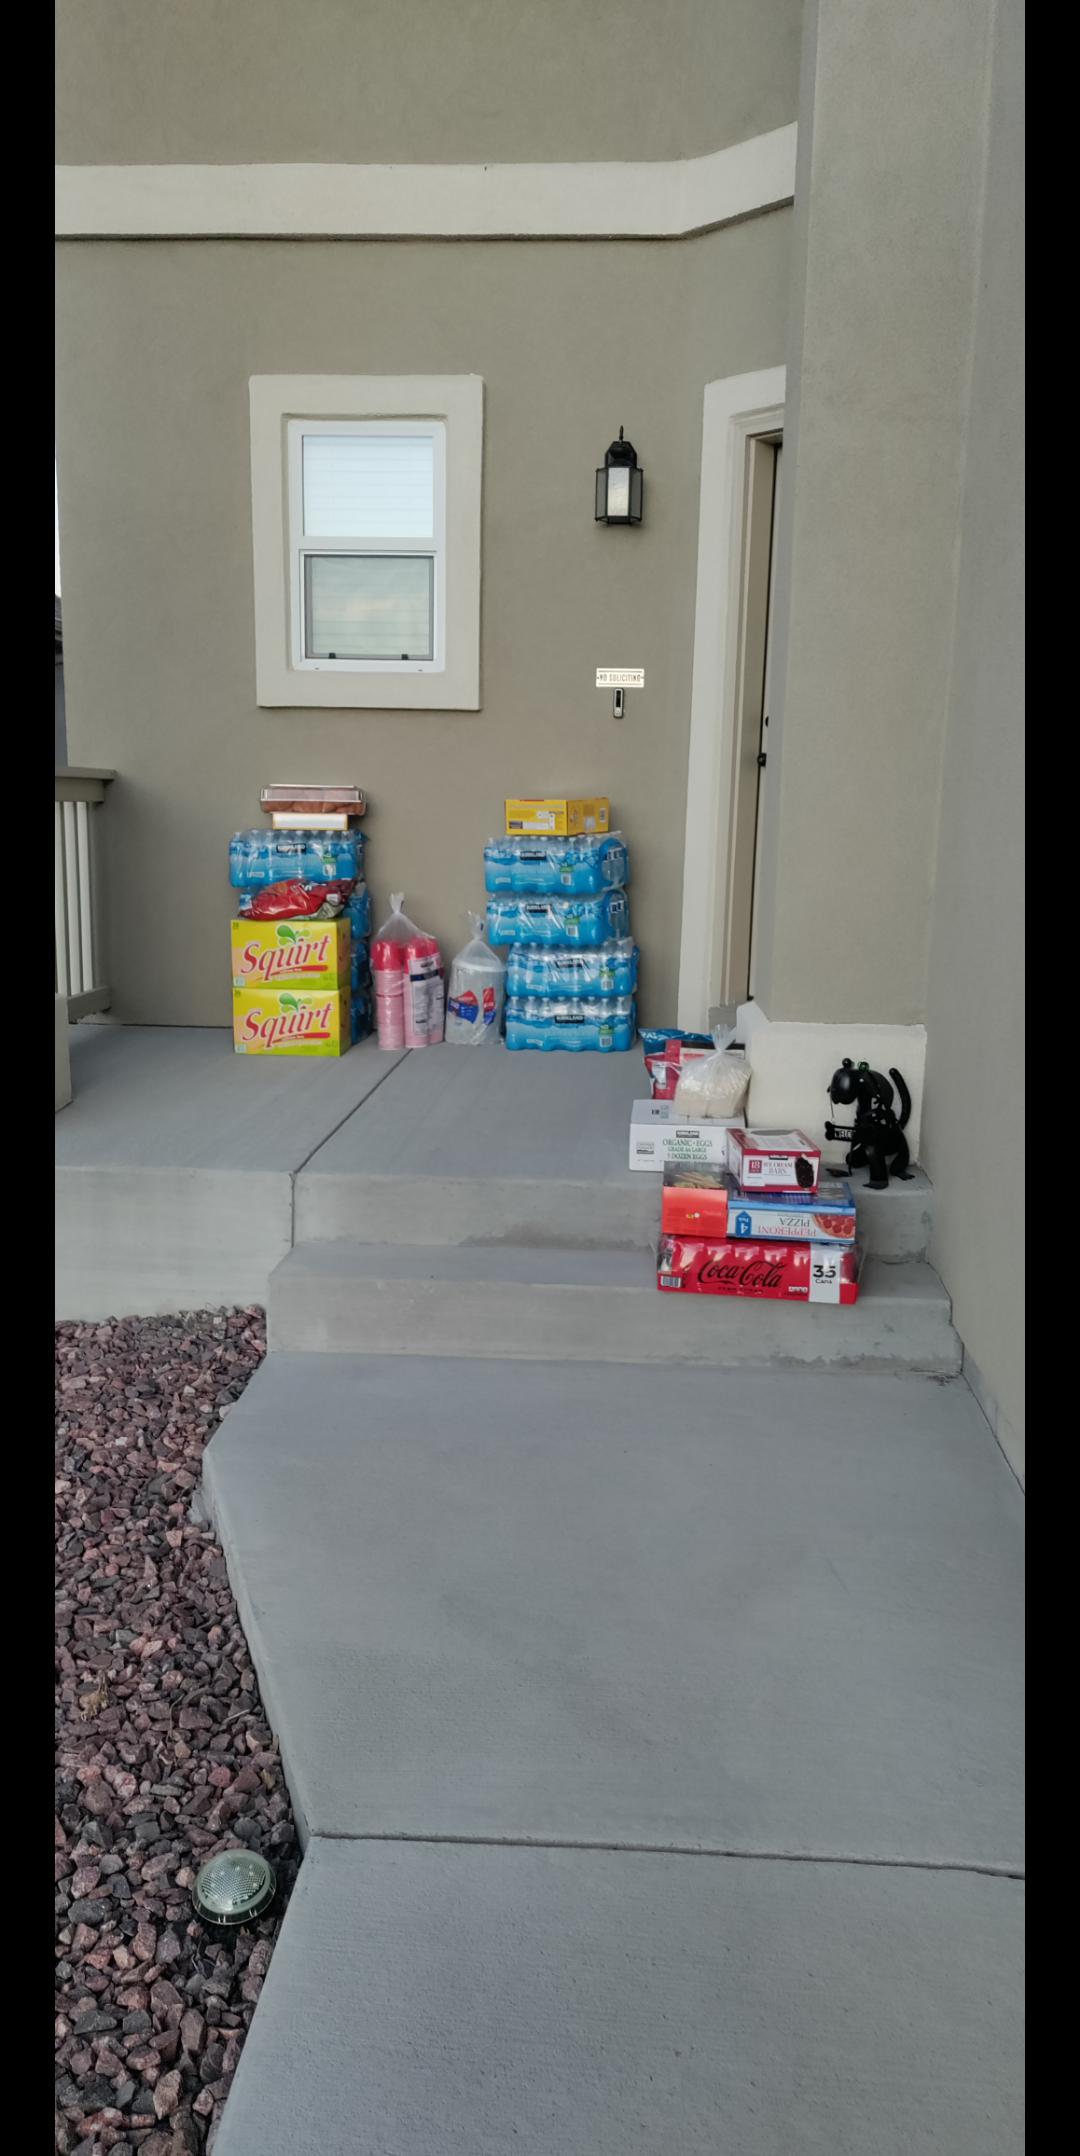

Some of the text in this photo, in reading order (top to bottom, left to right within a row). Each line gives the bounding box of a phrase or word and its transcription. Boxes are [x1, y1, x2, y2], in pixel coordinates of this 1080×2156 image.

[599, 673, 608, 681] NO
[240, 936, 331, 981] Squirt
[242, 1003, 332, 1048] Squirt
[662, 1138, 693, 1147] ORGANIC
[671, 1152, 692, 1160] DOZEN
[779, 1215, 810, 1227] PIZZA
[740, 1222, 748, 1235] 4
[758, 1224, 817, 1238] PEPPERONI
[697, 1260, 788, 1288] Coca-Cola
[812, 1264, 837, 1279] 35
